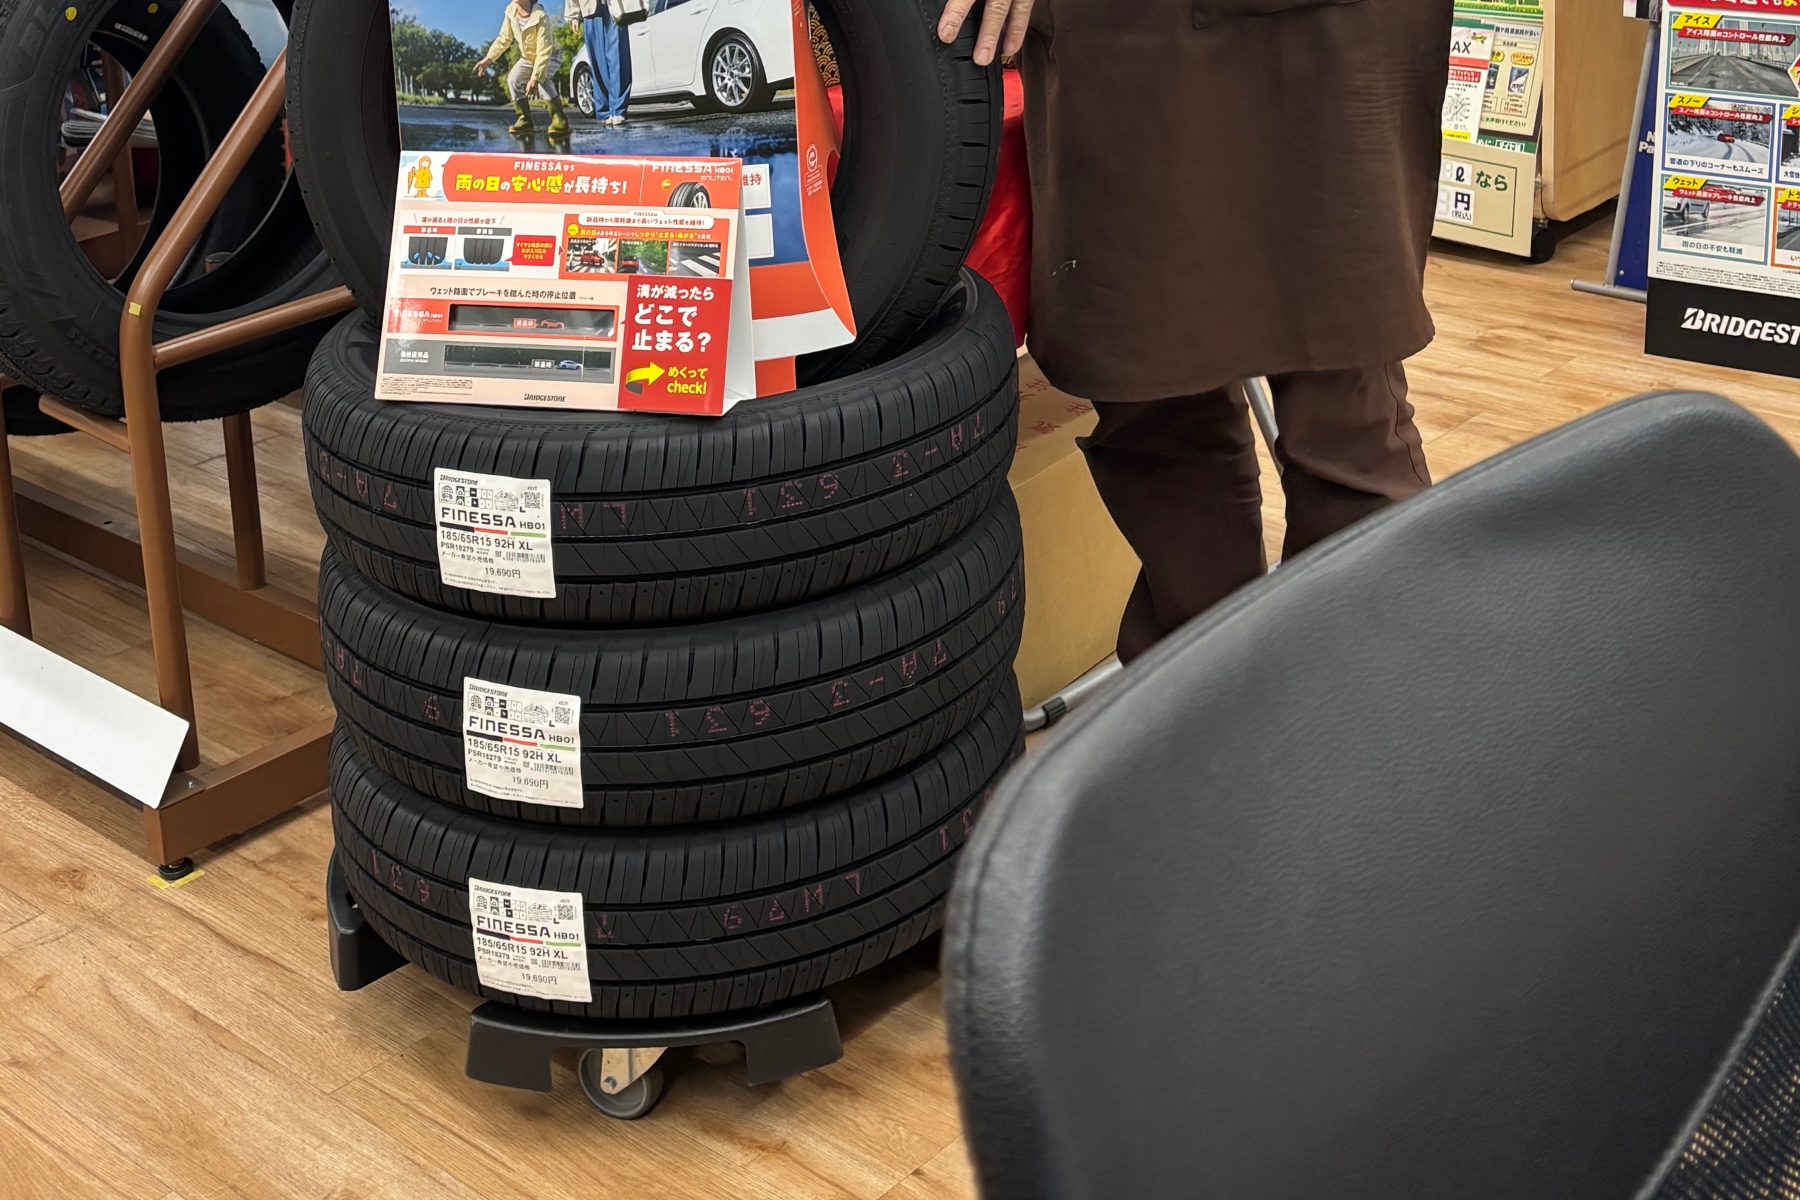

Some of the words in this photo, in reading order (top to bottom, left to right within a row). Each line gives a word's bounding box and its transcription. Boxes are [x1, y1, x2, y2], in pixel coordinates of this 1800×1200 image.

[1684, 14, 1711, 26] アイス
[1677, 95, 1701, 105] スノー
[513, 160, 576, 172] FINESSAなら
[1669, 157, 1764, 175] 雪道の下りのコーナーもスムーズ
[455, 173, 628, 195] 雨の日の安心感が長持ち!
[1475, 170, 1508, 191] なら
[1672, 177, 1699, 187] ウェット
[1454, 191, 1471, 211] 円
[1681, 240, 1743, 255] 雨の日の不安も軽減
[430, 286, 577, 300] ウェット路面でブレーキを踏んだ時の停止位置
[636, 283, 715, 301] 溝が減ったら
[634, 303, 698, 327] どこで
[631, 329, 712, 353] 止まる?
[667, 366, 709, 379] めくって
[441, 506, 517, 528] FINESSA
[519, 521, 545, 530] HB01
[440, 530, 492, 547] 185/65R15
[494, 538, 515, 549] 92H
[518, 540, 534, 551] XL
[469, 715, 546, 740] FINESSA
[548, 734, 575, 744] HB01
[467, 738, 520, 757] 185/65R15
[522, 749, 544, 761] 92H
[546, 753, 562, 763] XL
[476, 915, 551, 938] FINESSA
[553, 931, 579, 941] HB01
[476, 937, 527, 954] 185/65R15
[529, 947, 550, 958] 92H
[553, 949, 568, 960] XL
